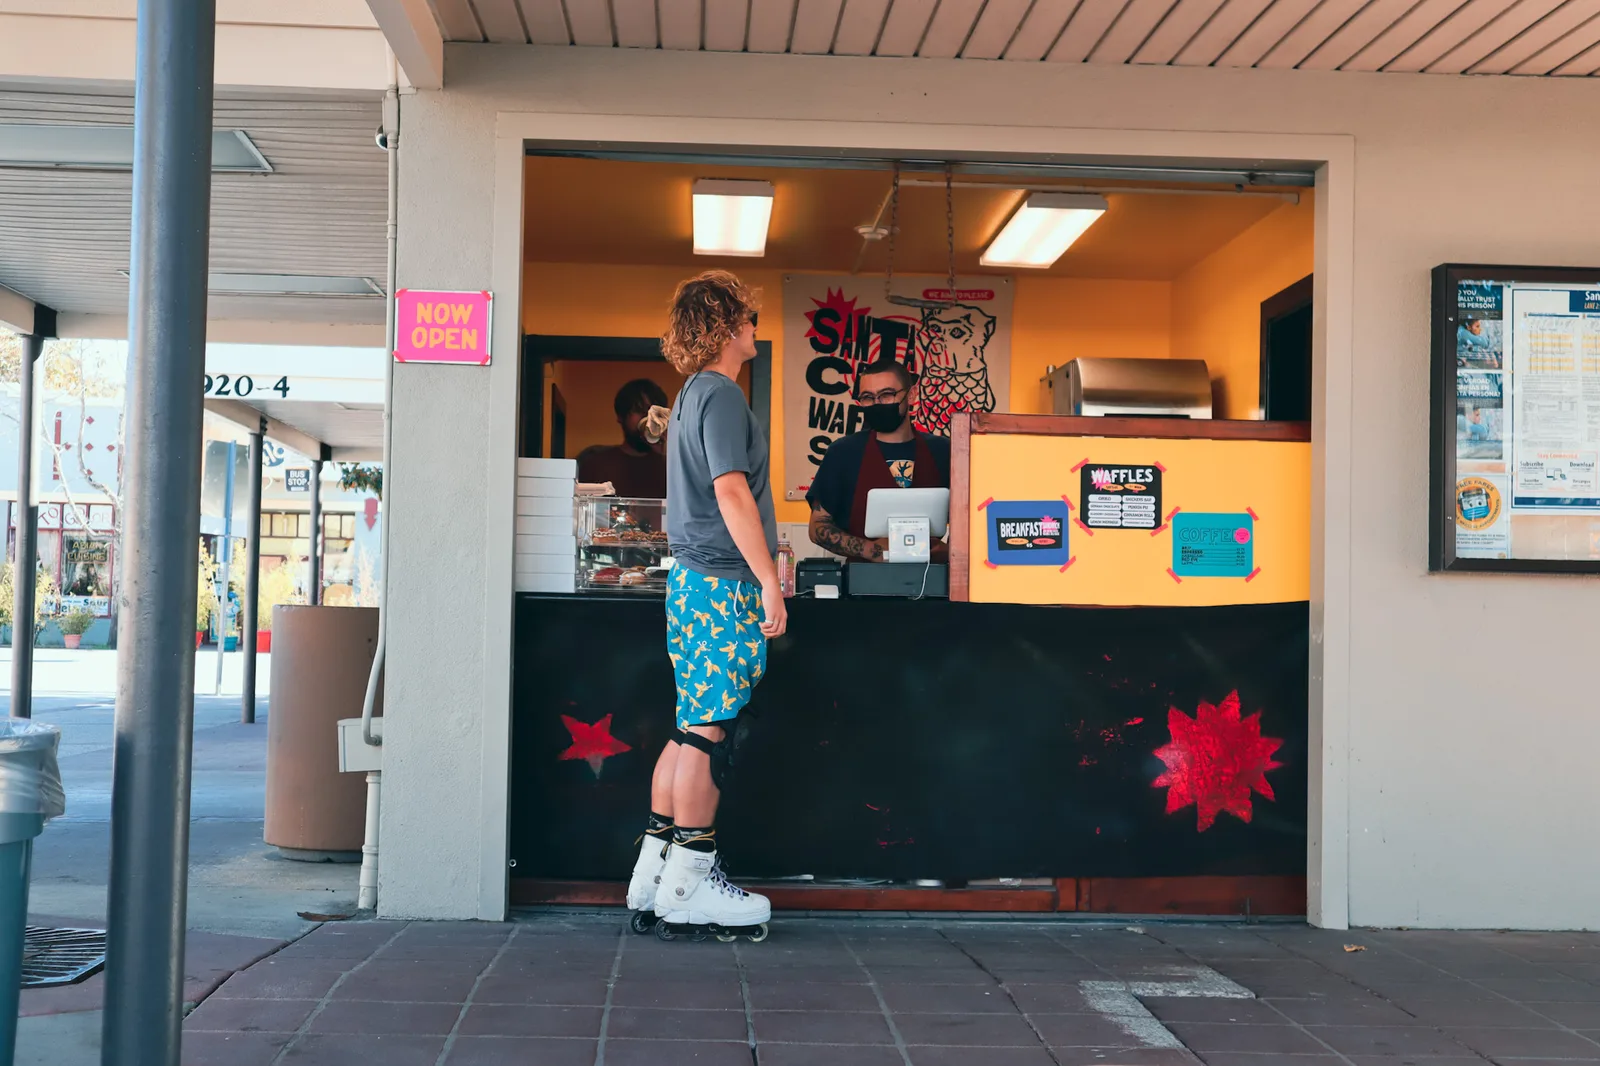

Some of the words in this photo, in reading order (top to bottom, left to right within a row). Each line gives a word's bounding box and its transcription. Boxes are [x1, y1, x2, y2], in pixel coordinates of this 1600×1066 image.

[416, 302, 474, 325] NOW
[411, 326, 478, 351] OPEN
[809, 308, 916, 371] SANTA
[290, 470, 305, 478] BUS
[1091, 469, 1153, 483] WAFFLES
[287, 478, 307, 486] STOP
[39, 507, 59, 526] TO
[1000, 522, 1043, 537] BREAKFAST
[67, 552, 105, 561] CUISINE
